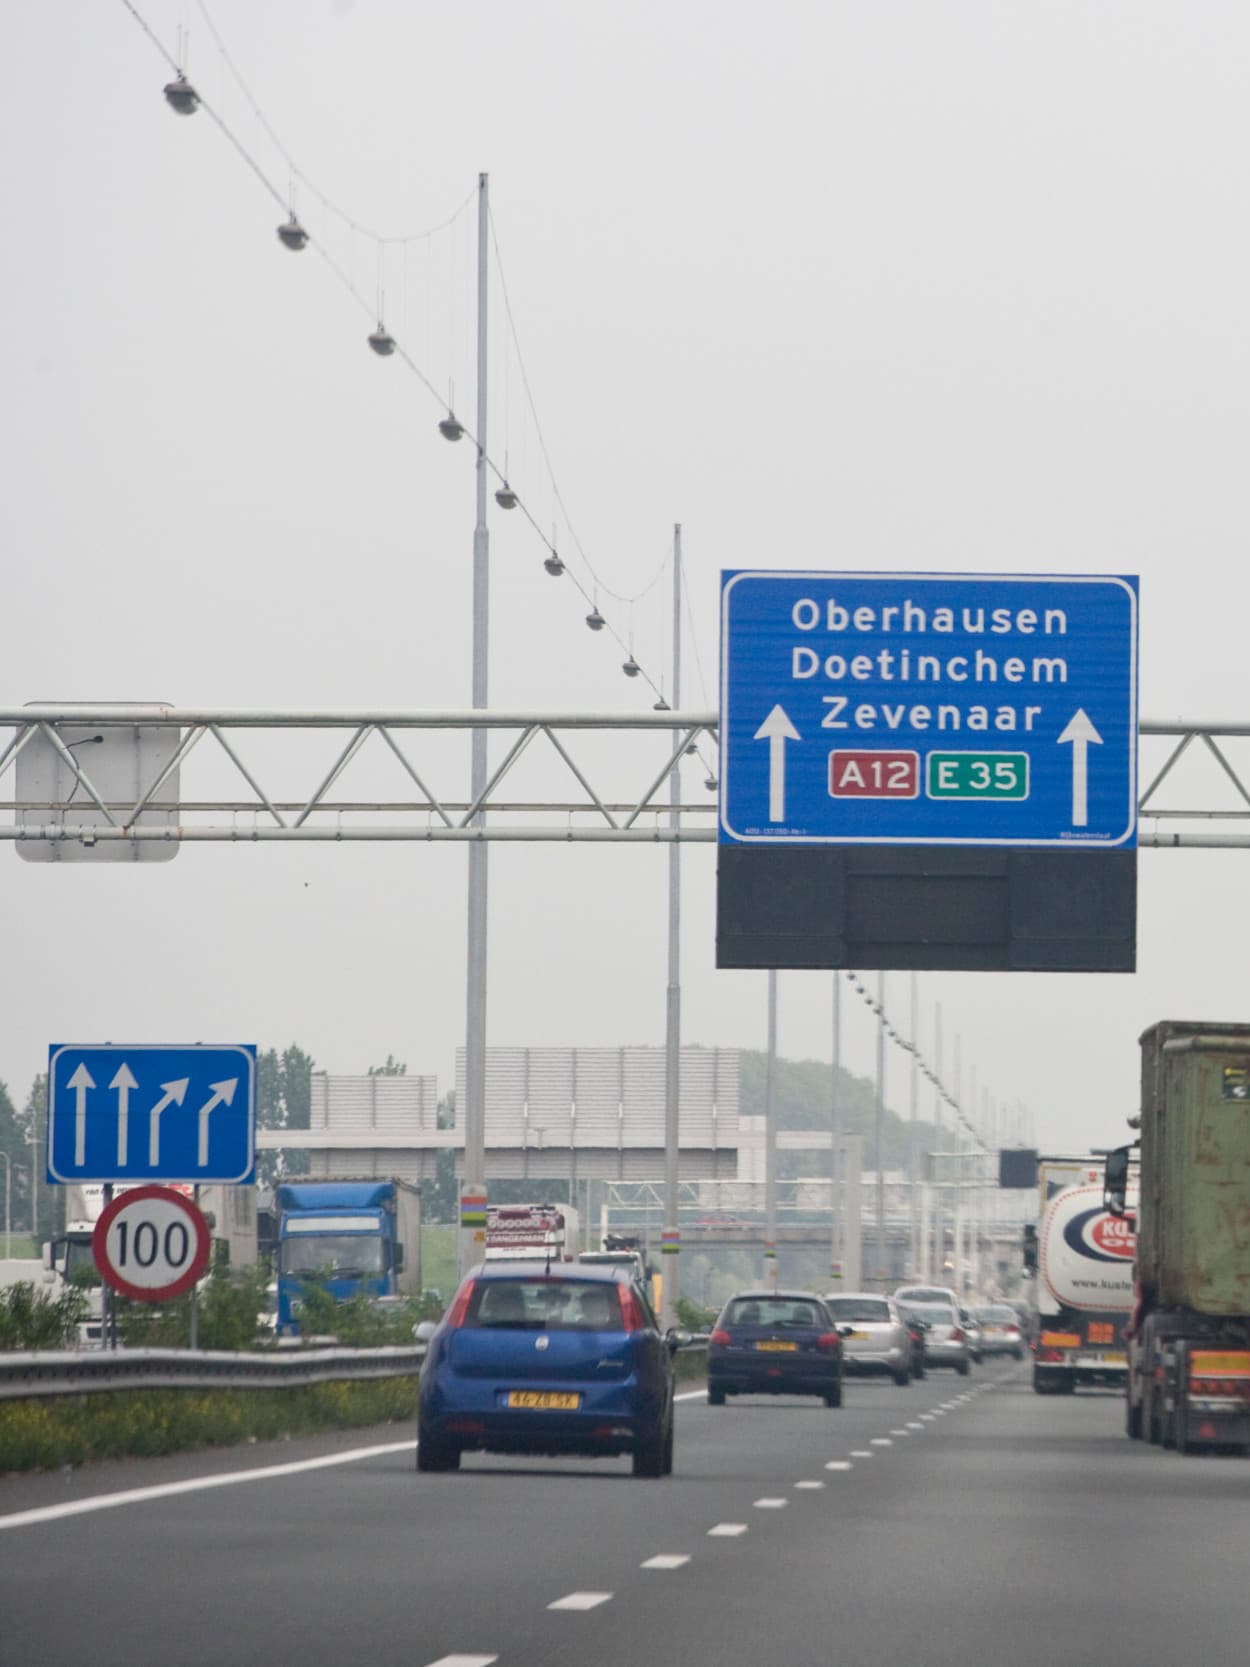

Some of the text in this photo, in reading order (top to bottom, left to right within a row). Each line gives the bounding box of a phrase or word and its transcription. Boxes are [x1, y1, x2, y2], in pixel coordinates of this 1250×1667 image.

[791, 598, 1068, 635] Oberhausen
[791, 646, 1068, 683] Doetinchem
[820, 695, 1042, 731] Zevenaar
[837, 760, 911, 789] A12
[938, 761, 1018, 791] E 35
[116, 1220, 190, 1268] 100
[1102, 1220, 1136, 1238] KU
